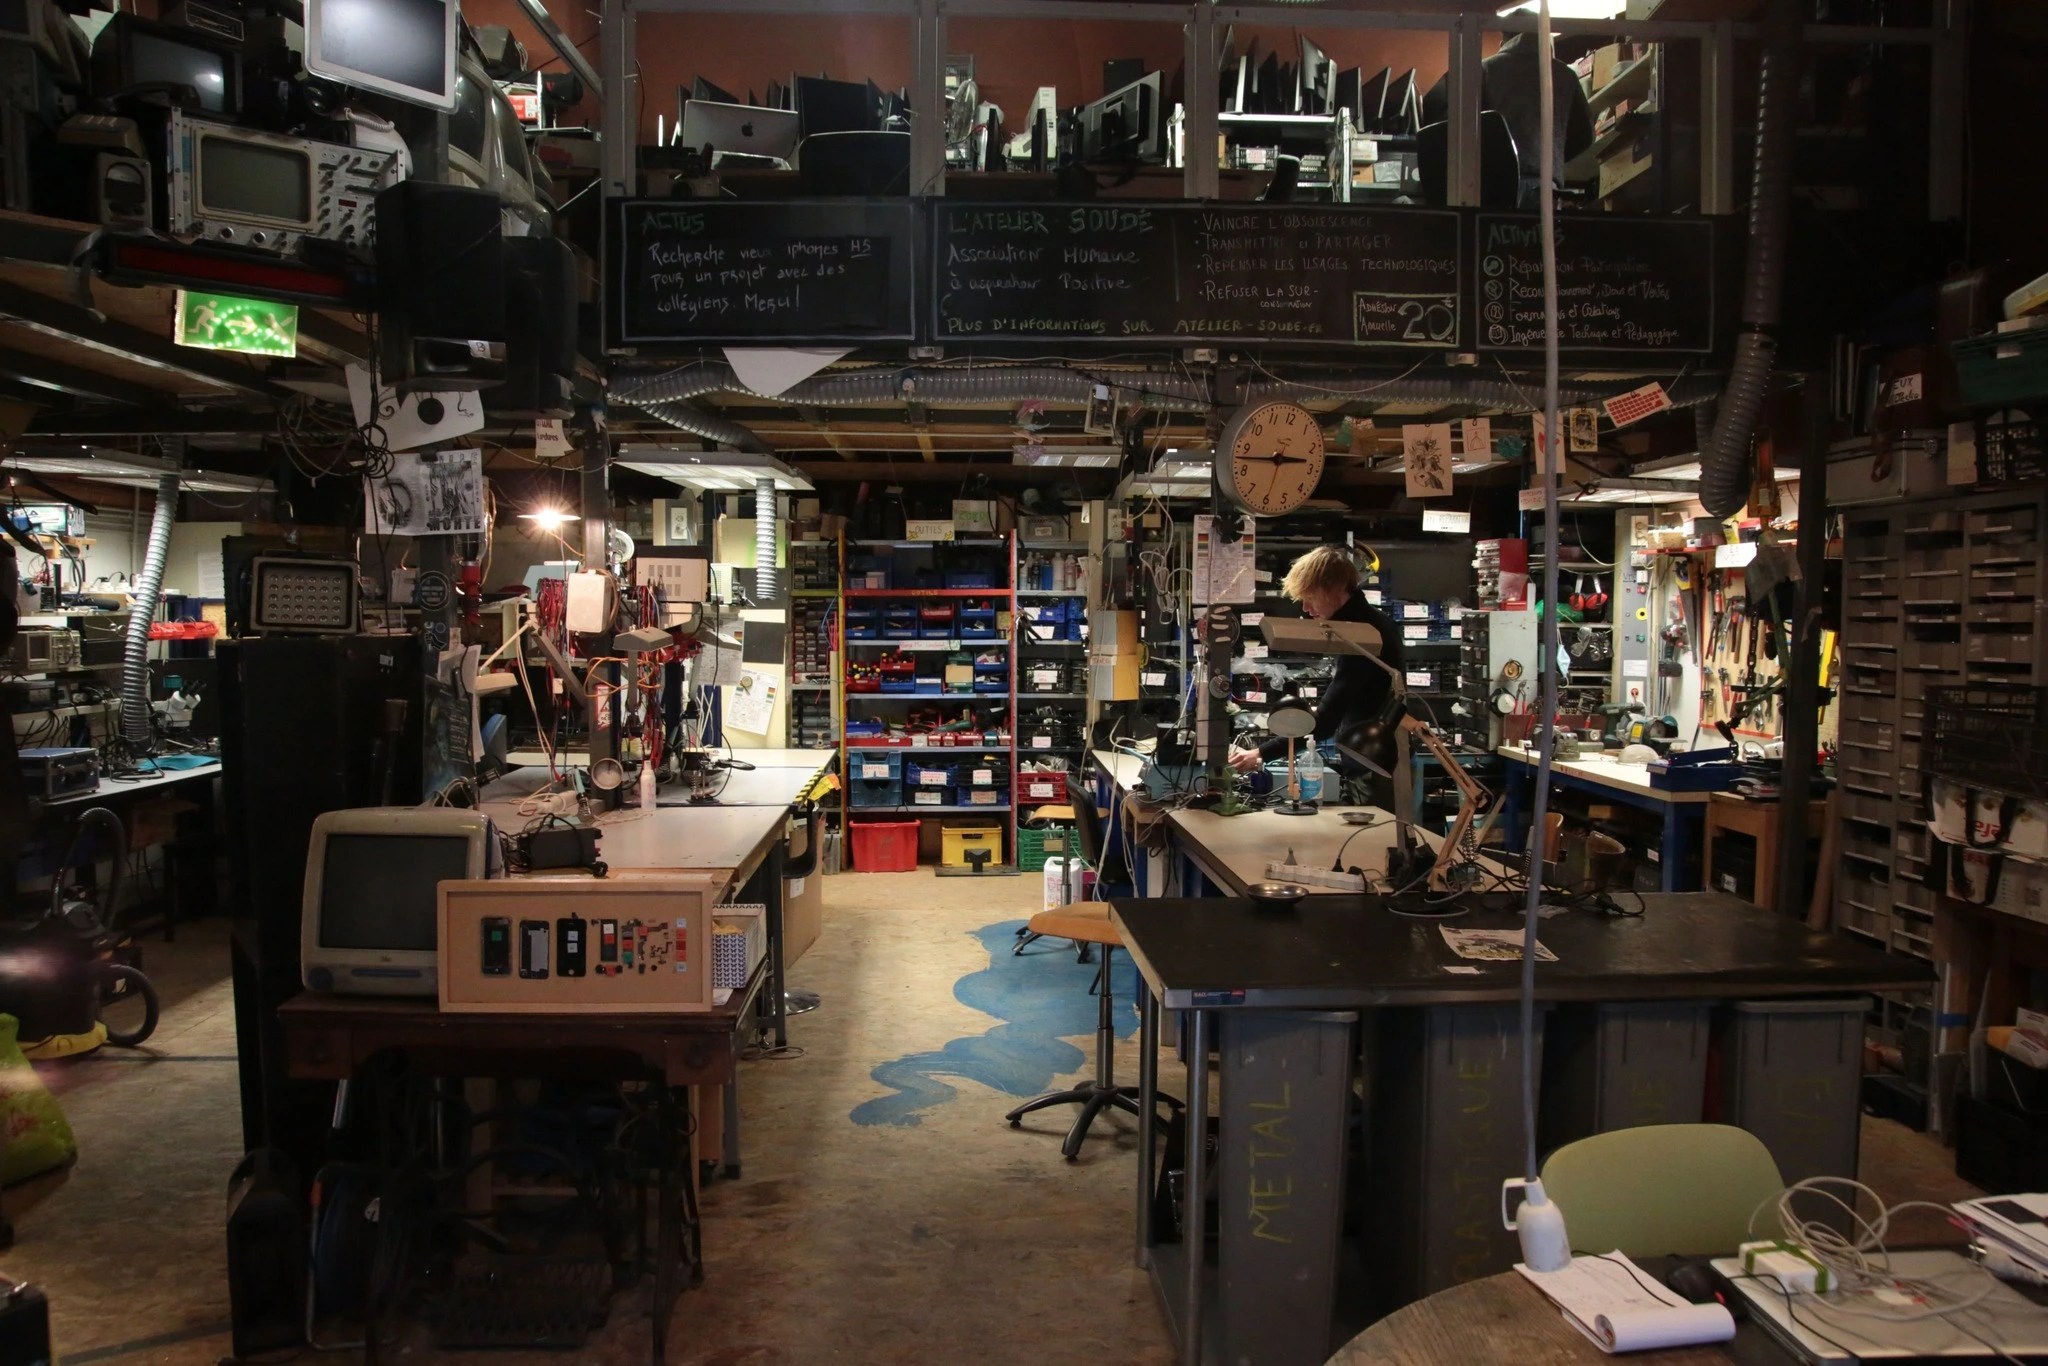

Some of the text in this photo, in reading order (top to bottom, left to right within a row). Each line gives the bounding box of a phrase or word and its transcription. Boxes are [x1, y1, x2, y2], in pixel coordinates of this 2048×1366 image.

[641, 211, 704, 235] ACTUS
[950, 208, 1153, 234] L'ATELIER SOUDÉ
[1202, 213, 1259, 231] VAINCRE
[851, 239, 872, 252] HS
[1316, 233, 1392, 250] PARTAGER
[695, 270, 712, 283] un
[777, 267, 809, 280] avec
[816, 263, 845, 277] des
[1275, 258, 1294, 271] LES
[1361, 258, 1456, 275] TECHNOLOGIQUES
[1059, 271, 1132, 290] Positive
[1266, 286, 1284, 297] LA
[1122, 320, 1154, 334] SUR
[1398, 301, 1454, 341] 20
[1269, 413, 1278, 425] 11
[1286, 412, 1296, 426] 12
[1251, 423, 1263, 436] 10
[1243, 443, 1251, 454] 9
[1309, 442, 1316, 454] 2
[1240, 464, 1248, 476] 8
[1307, 463, 1314, 475] 3
[1248, 482, 1256, 494] 7
[1297, 482, 1304, 492] 4
[1262, 494, 1270, 505] 6
[1280, 492, 1288, 504] 5
[914, 525, 943, 535] OUTILS
[1248, 1080, 1297, 1244] METAL
